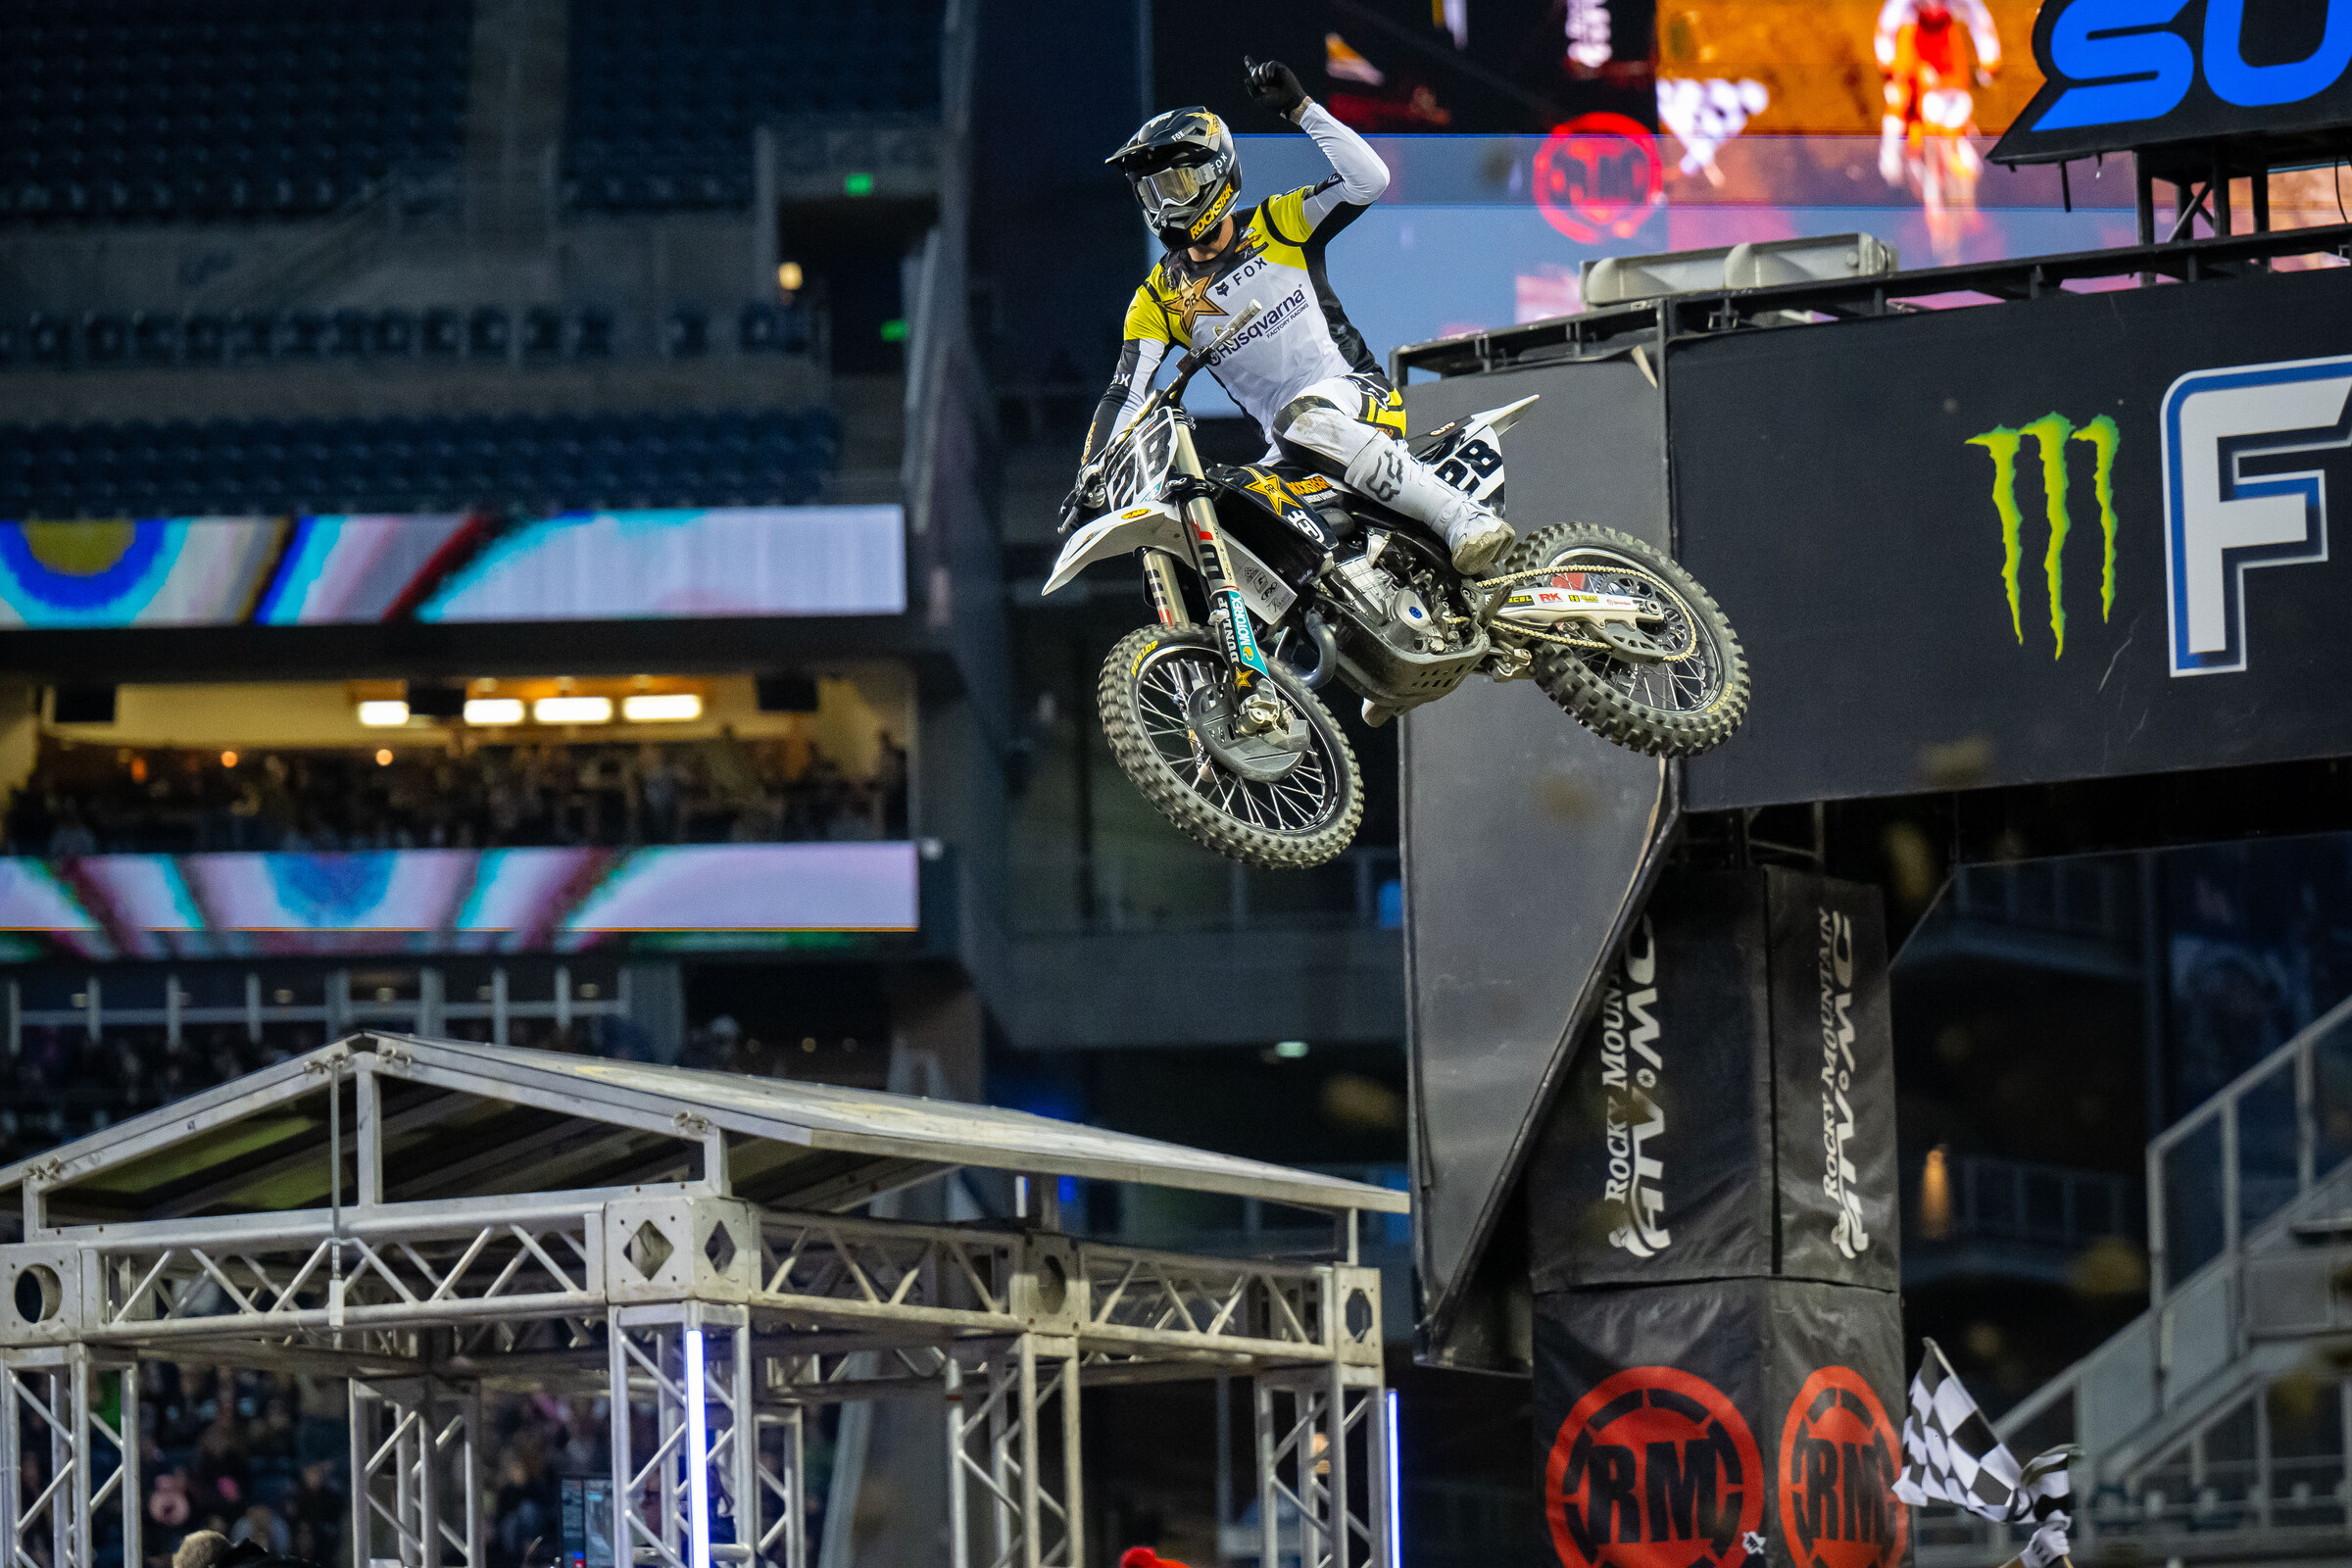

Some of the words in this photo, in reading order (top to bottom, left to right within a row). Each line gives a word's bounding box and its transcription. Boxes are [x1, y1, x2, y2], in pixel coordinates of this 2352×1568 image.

[1171, 130, 1186, 142] FOX
[1189, 182, 1234, 240] ROCKSTAR
[1232, 257, 1268, 286] FOX
[1215, 288, 1305, 360] Husqvarna
[1266, 318, 1291, 339] FACTORY
[1290, 303, 1309, 320] RACING
[1285, 475, 1333, 496] ROCKSTAR
[1230, 595, 1251, 646] MOTOREX
[1539, 592, 1562, 603] RK
[1131, 640, 1158, 678] DUNLOP
[1819, 906, 1838, 1091] MOUNTAIN
[1604, 1096, 1630, 1201] ROCKY
[1822, 1092, 1843, 1204] ROCKY
[1586, 1439, 1717, 1546] RM
[1807, 1437, 1886, 1544] RM
